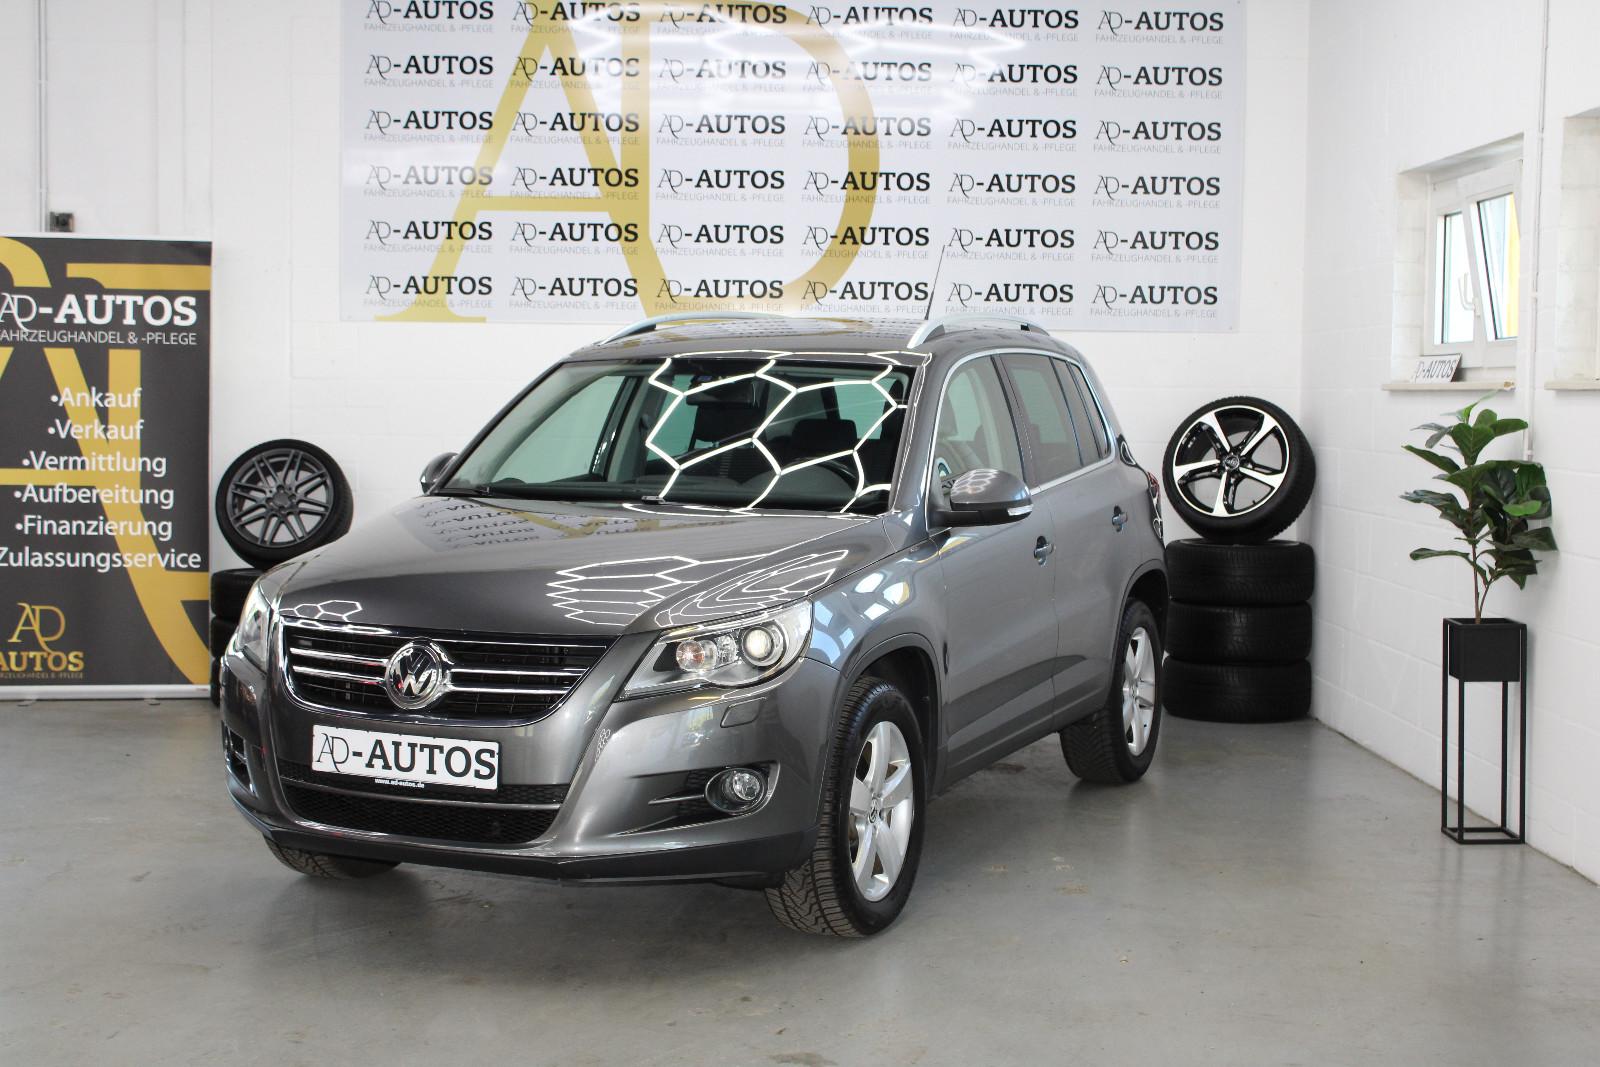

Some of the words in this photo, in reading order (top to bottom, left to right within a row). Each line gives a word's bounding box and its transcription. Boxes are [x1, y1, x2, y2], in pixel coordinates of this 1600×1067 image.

[365, 0, 494, 25] AD-AUTOS
[953, 8, 1078, 29] AD-AUTOS
[1098, 10, 1224, 37] AD-AUTOS
[365, 55, 494, 80] AD-AUTOS
[1096, 65, 1222, 91] AD-AUTOS
[365, 109, 493, 136] AD-AUTOS
[512, 111, 639, 138] AD-AUTOS
[658, 114, 786, 140] AD-AUTOS
[804, 116, 932, 142] AD-AUTOS
[951, 118, 1076, 144] AD-AUTOS
[1096, 120, 1221, 146] AD-AUTOS
[365, 165, 493, 191] AD-AUTOS
[512, 166, 639, 192] AD-AUTOS
[658, 168, 785, 195] AD-AUTOS
[804, 170, 930, 197] AD-AUTOS
[950, 173, 1076, 200] AD-AUTOS
[1094, 175, 1220, 201] AD-AUTOS
[365, 219, 492, 246] AD-AUTOS
[511, 221, 638, 248] AD-AUTOS
[657, 223, 784, 250] AD-AUTOS
[803, 226, 930, 252] AD-AUTOS
[949, 228, 1074, 254] AD-AUTOS
[1094, 230, 1219, 256] AD-AUTOS
[365, 274, 492, 301] AD-AUTOS
[511, 276, 638, 302] AD-AUTOS
[656, 278, 784, 304] AD-AUTOS
[802, 280, 928, 306] AD-AUTOS
[948, 282, 1074, 308] AD-AUTOS
[1092, 284, 1218, 311] AD-AUTOS
[0, 328, 124, 343] AHRZEUGHANDEL
[127, 332, 138, 343] &
[141, 332, 197, 345] -PFLEGE
[58, 387, 142, 408] Ankauf
[55, 419, 144, 440] Verkauf
[30, 451, 167, 478] Vermittlung
[22, 483, 174, 509] Aufbereitung
[24, 515, 172, 541] Finanzierung
[317, 732, 497, 781] AD-AUTOS
